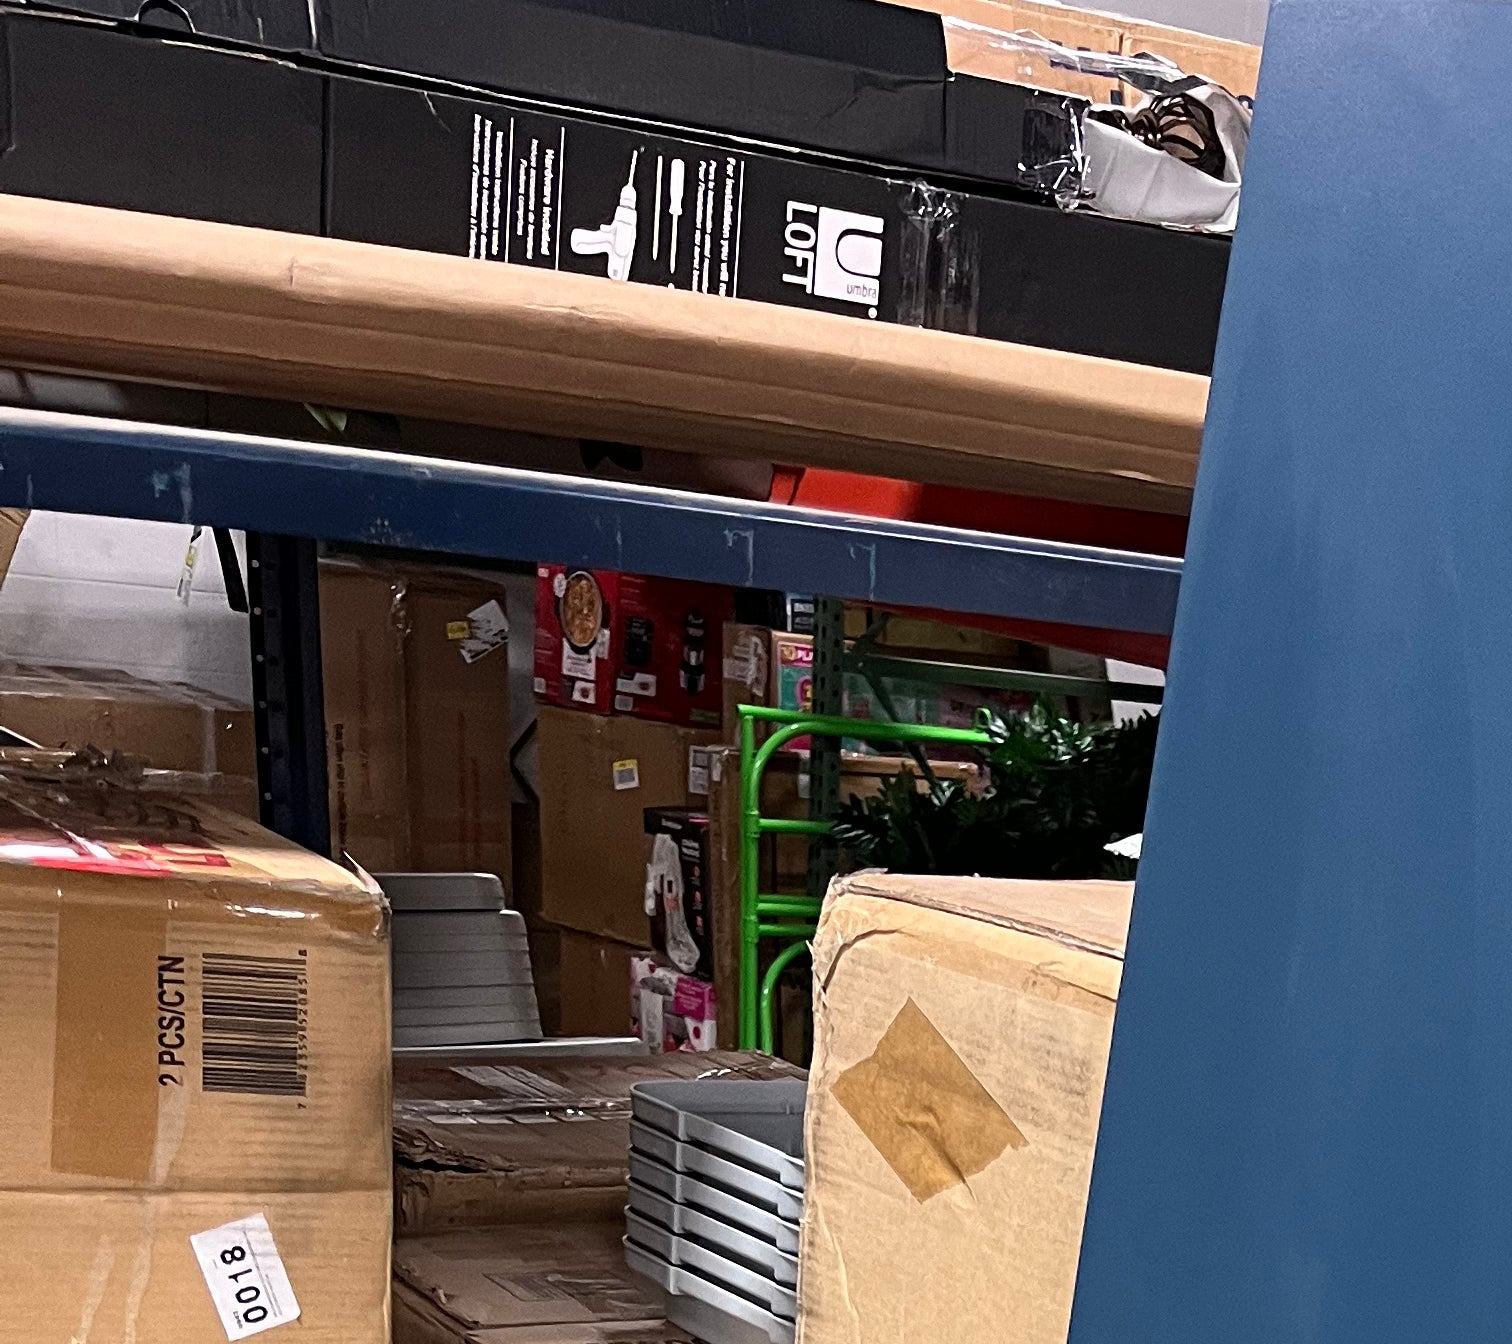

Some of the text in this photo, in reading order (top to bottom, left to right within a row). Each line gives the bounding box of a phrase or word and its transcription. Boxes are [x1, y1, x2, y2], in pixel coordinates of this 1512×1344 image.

[782, 200, 818, 294] LOFT
[846, 283, 877, 299] umbra
[158, 955, 185, 1066] PCS/CTN
[220, 1244, 269, 1325] 0018
